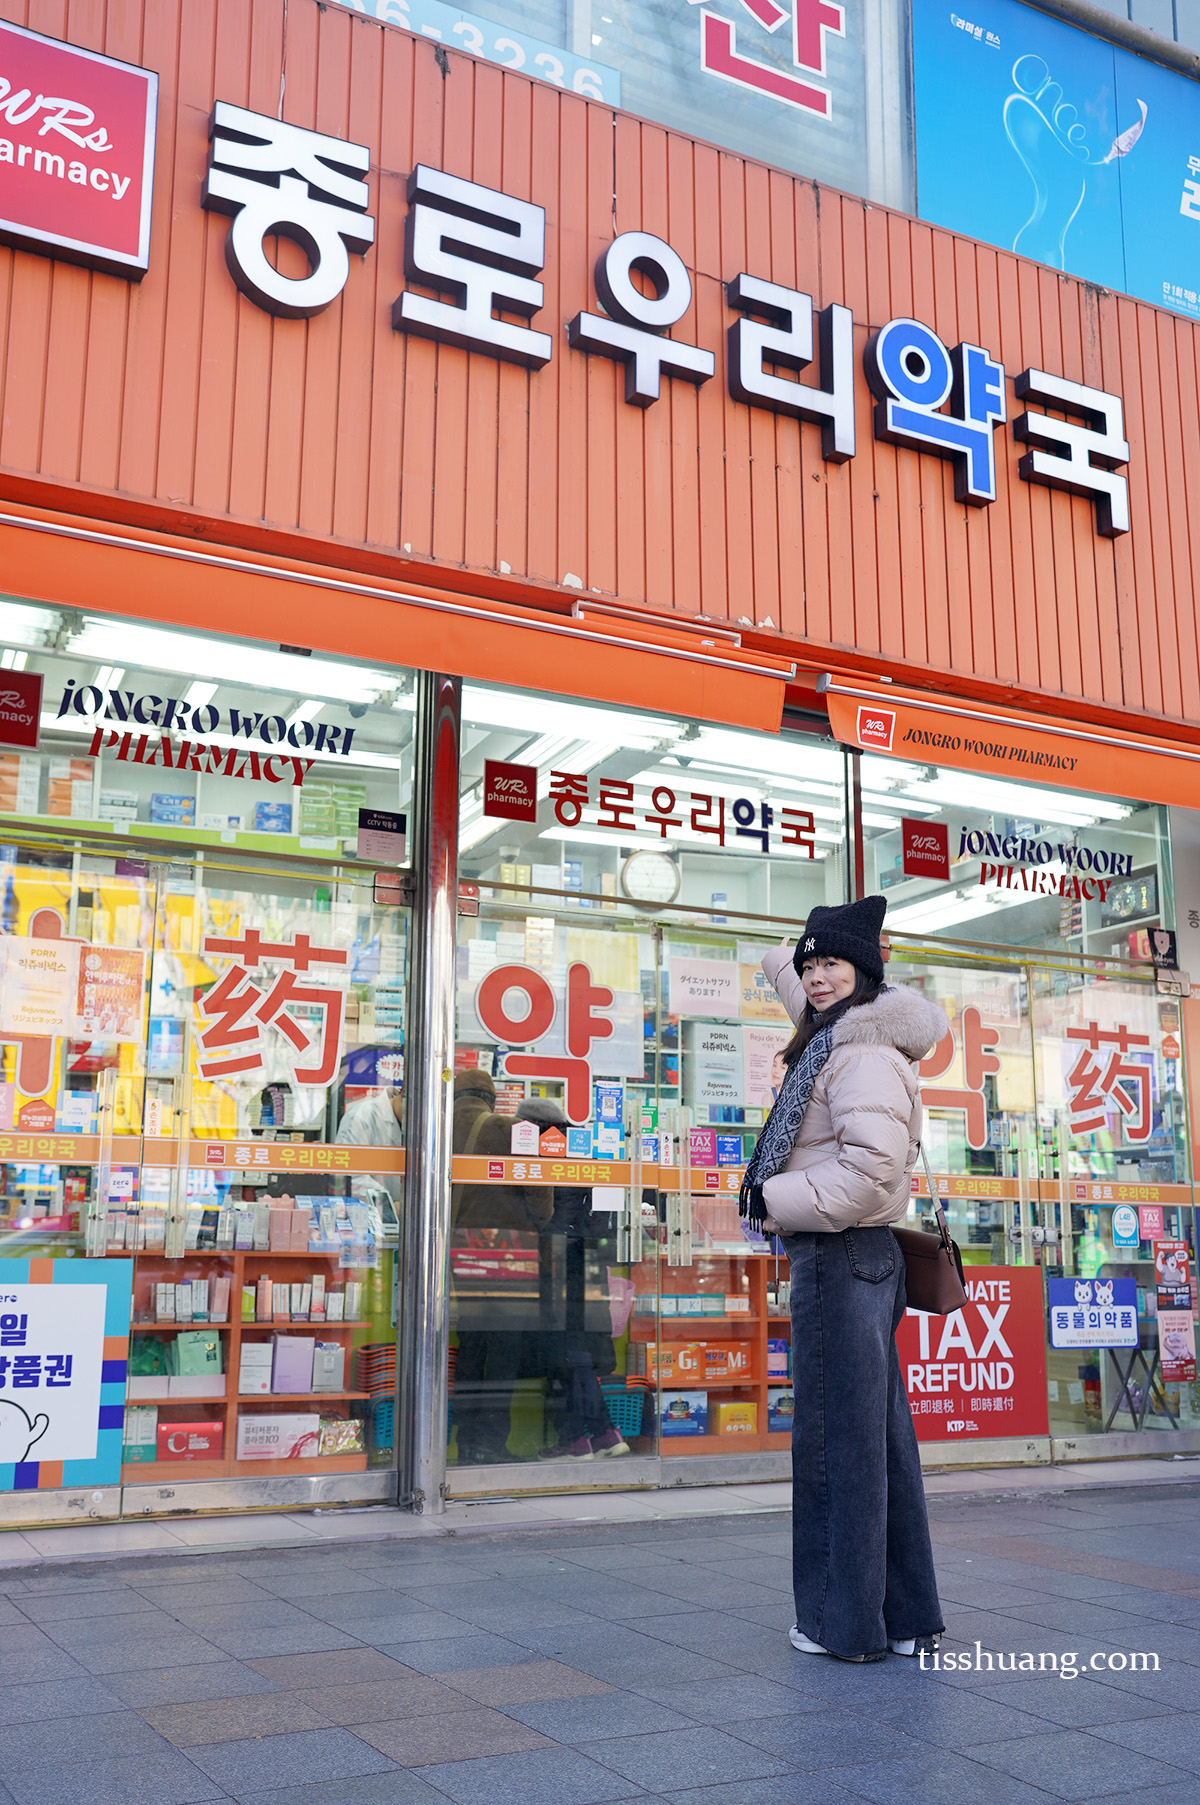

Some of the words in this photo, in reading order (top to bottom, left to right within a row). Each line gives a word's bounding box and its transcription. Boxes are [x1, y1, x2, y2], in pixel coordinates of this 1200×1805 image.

[202, 100, 1131, 539] 종로우리약국
[230, 709, 357, 756] WOORI
[861, 728, 888, 739] pharmacy
[86, 726, 317, 787] PHARMACY
[902, 728, 961, 751] JONGRO
[963, 738, 1007, 759] WOORI
[1008, 746, 1078, 771] PHARMACY
[487, 792, 534, 808] pharmacy
[548, 769, 816, 860] 종로우리약국
[906, 849, 946, 864] pharmacy
[1057, 843, 1133, 877] WOORI
[979, 862, 1112, 903] PHARMACY
[31, 949, 56, 958] PDRN
[197, 926, 351, 1089] 药
[475, 960, 616, 1126] 약
[702, 1042, 737, 1052] 리쥬비넥스
[381, 1061, 404, 1071] 박카
[1065, 1021, 1154, 1144] 药
[690, 1136, 711, 1147] TAX
[234, 1146, 270, 1165] 종로
[280, 1148, 351, 1169] 우리약국
[512, 1162, 543, 1180] 종로
[551, 1164, 611, 1182] 우리약국
[955, 1179, 1002, 1196] 우리약국
[1091, 1184, 1113, 1199] 종로
[1118, 1186, 1160, 1201] 우리약국
[1143, 1213, 1159, 1222] TAX
[0, 1314, 28, 1346] 일
[1056, 1311, 1133, 1329] 동물의약품
[906, 1304, 1014, 1360] TAX
[907, 1361, 1015, 1394] REFUND
[946, 1420, 965, 1432] KTP
